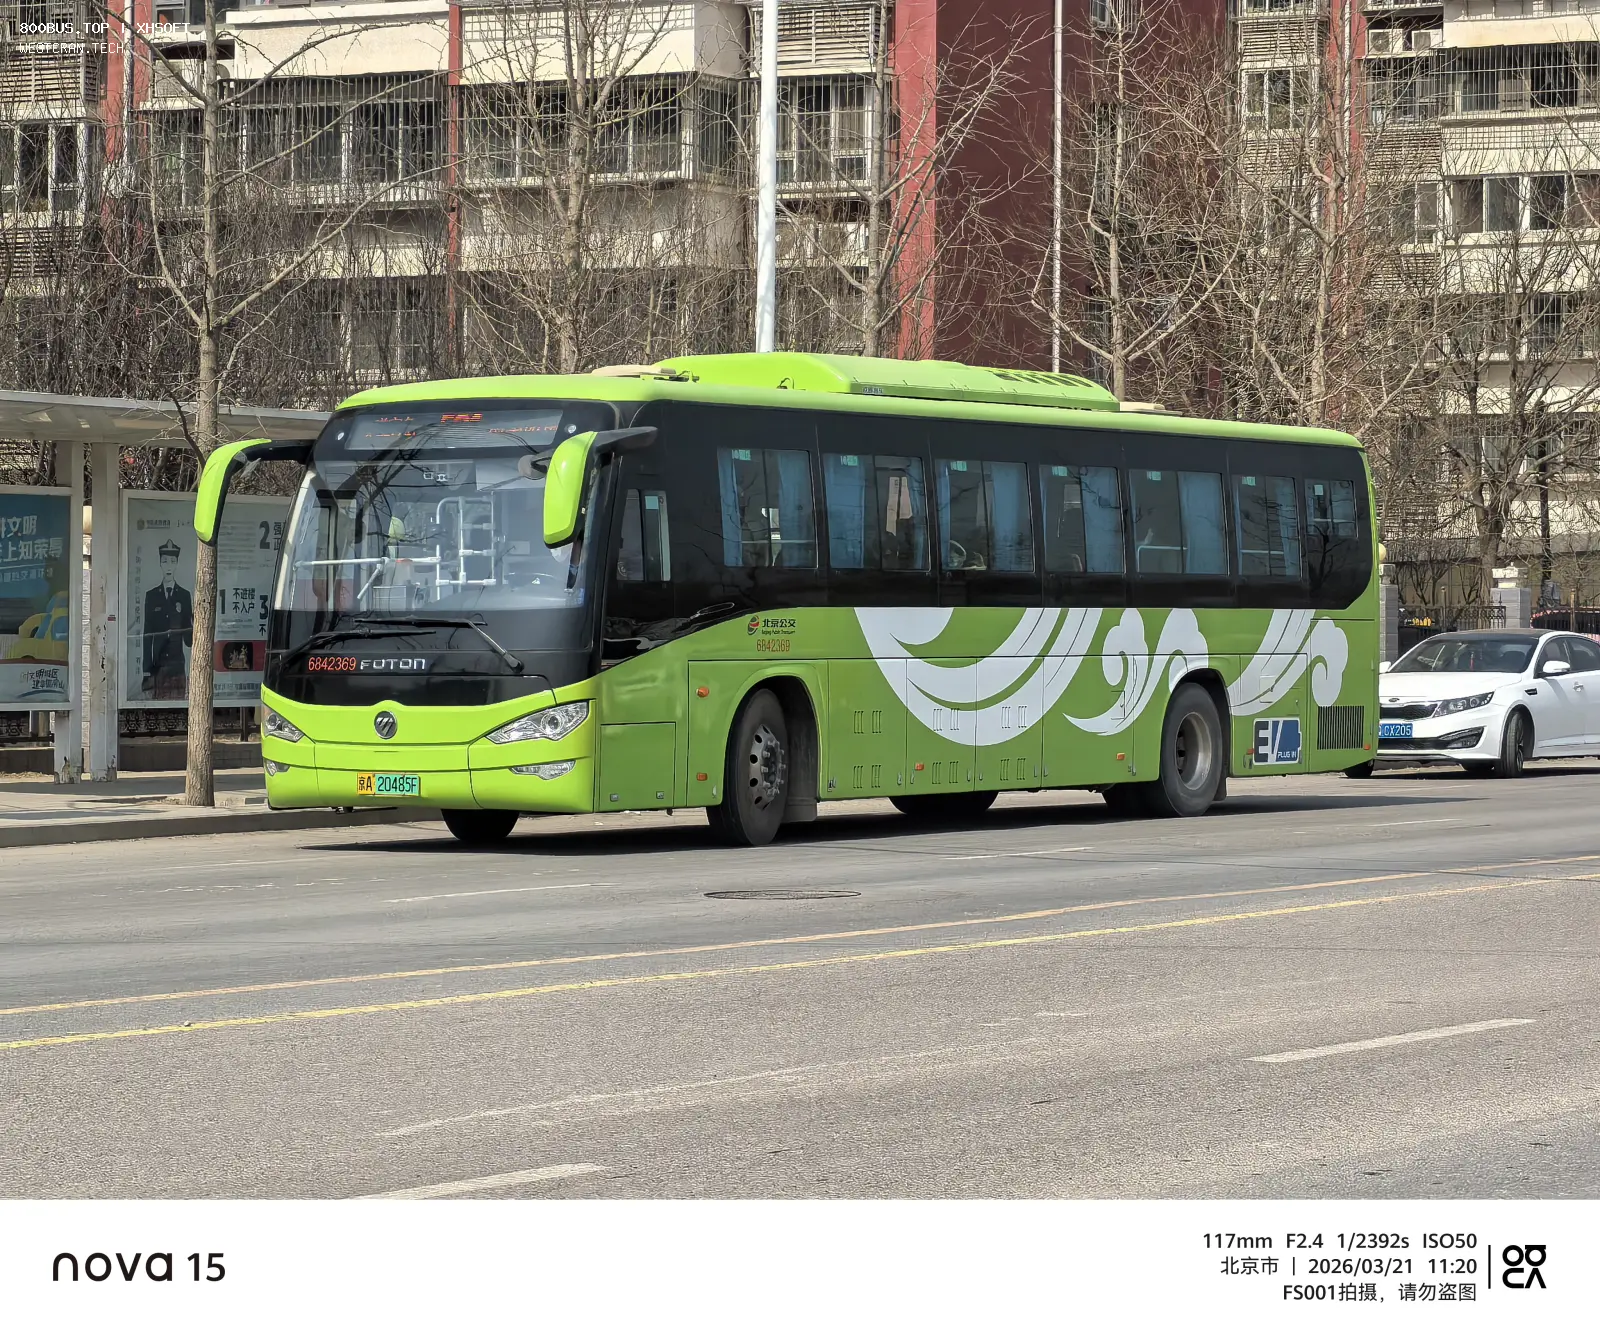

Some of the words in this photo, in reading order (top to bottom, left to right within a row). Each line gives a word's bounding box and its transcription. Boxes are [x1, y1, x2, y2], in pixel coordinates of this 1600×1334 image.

[259, 520, 270, 549] 2
[0, 537, 63, 563] 上知荣辱
[219, 589, 226, 615] 1
[232, 601, 255, 614] 不入户
[259, 594, 269, 620] 3
[762, 618, 796, 628] 北京公交
[308, 656, 357, 671] 6842369
[360, 658, 426, 670] FOTON
